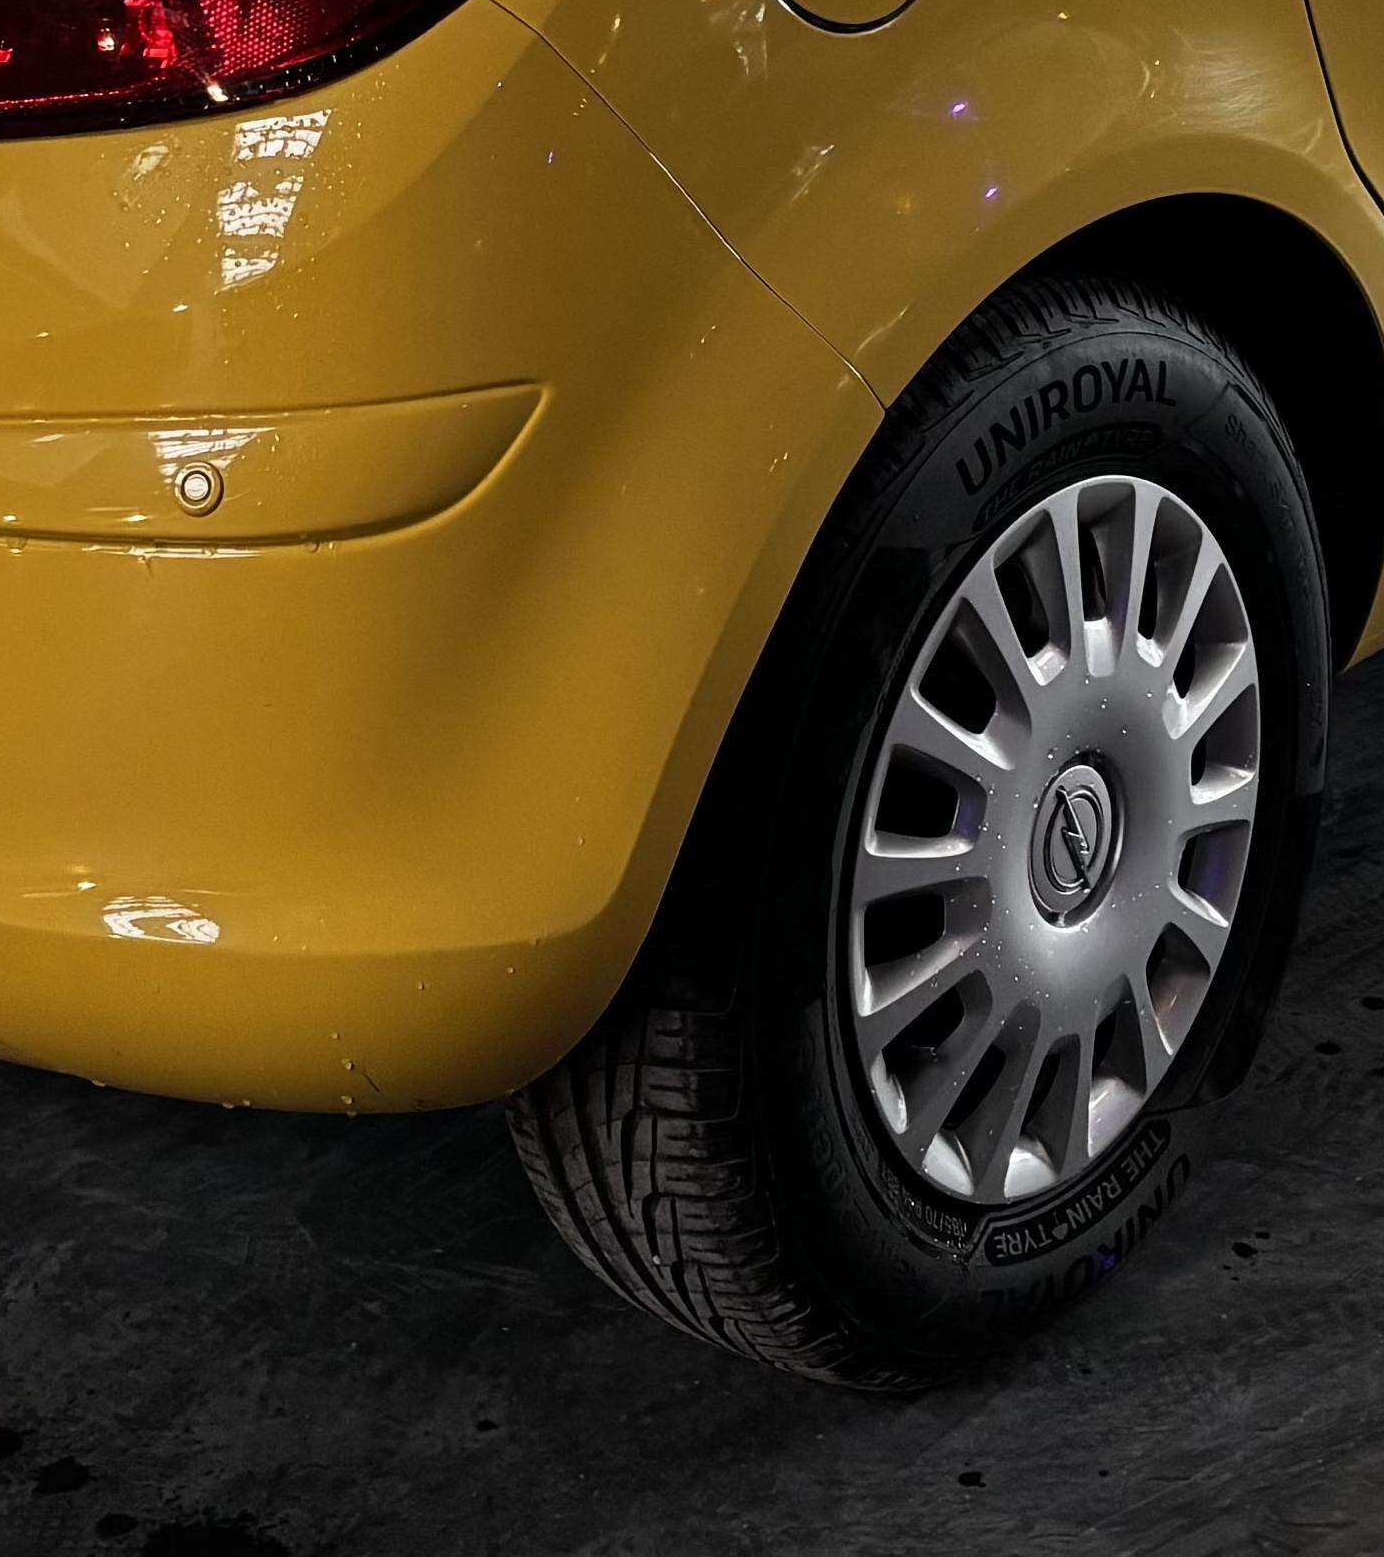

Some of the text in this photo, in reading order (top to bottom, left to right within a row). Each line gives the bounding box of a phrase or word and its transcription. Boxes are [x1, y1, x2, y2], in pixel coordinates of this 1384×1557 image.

[955, 358, 1177, 496] UNIROYAL
[993, 1128, 1166, 1259] THE RAIN TYRE
